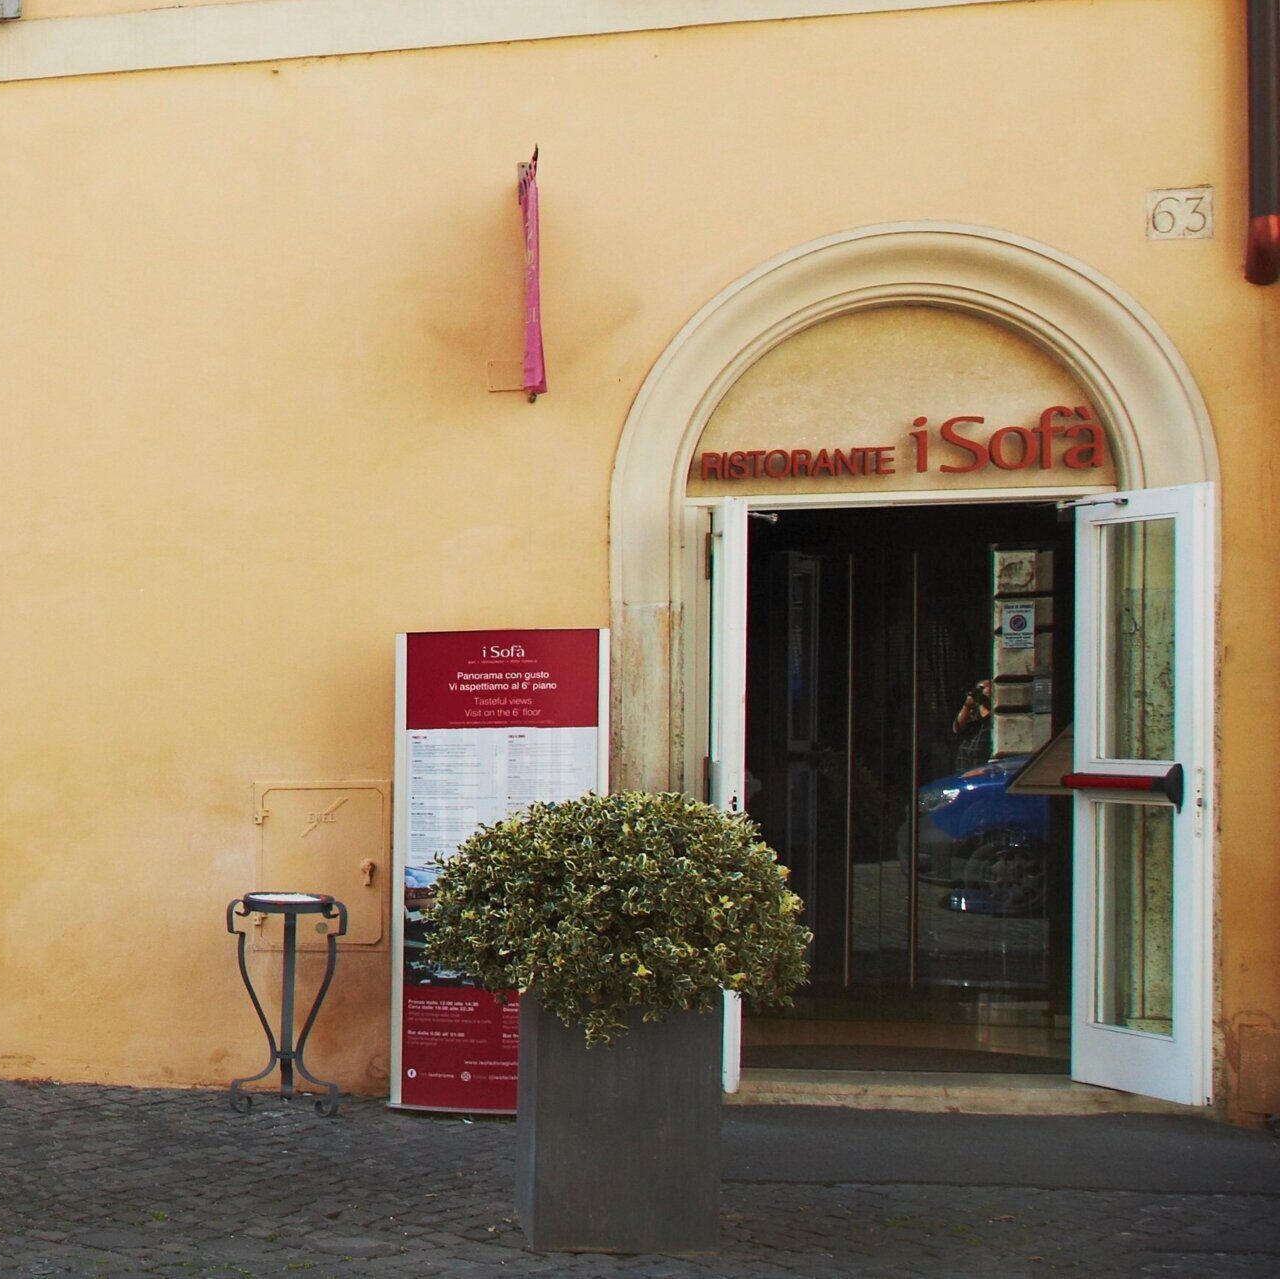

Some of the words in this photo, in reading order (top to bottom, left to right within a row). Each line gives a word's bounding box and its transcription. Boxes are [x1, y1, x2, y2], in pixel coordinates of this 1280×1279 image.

[1151, 196, 1207, 233] 63
[701, 446, 896, 481] RISTORANTE
[940, 405, 1105, 474] Sofà
[490, 645, 525, 658] Sofà
[457, 671, 503, 680] Panorama
[524, 671, 550, 681] gusto
[448, 682, 458, 691] Vi
[459, 682, 509, 693] aspettiamo
[511, 682, 520, 690] al
[532, 681, 557, 692] piano
[474, 696, 507, 706] Tasteful
[509, 698, 533, 706] views
[464, 708, 482, 718] Visit
[497, 708, 511, 717] the
[522, 708, 542, 717] floor
